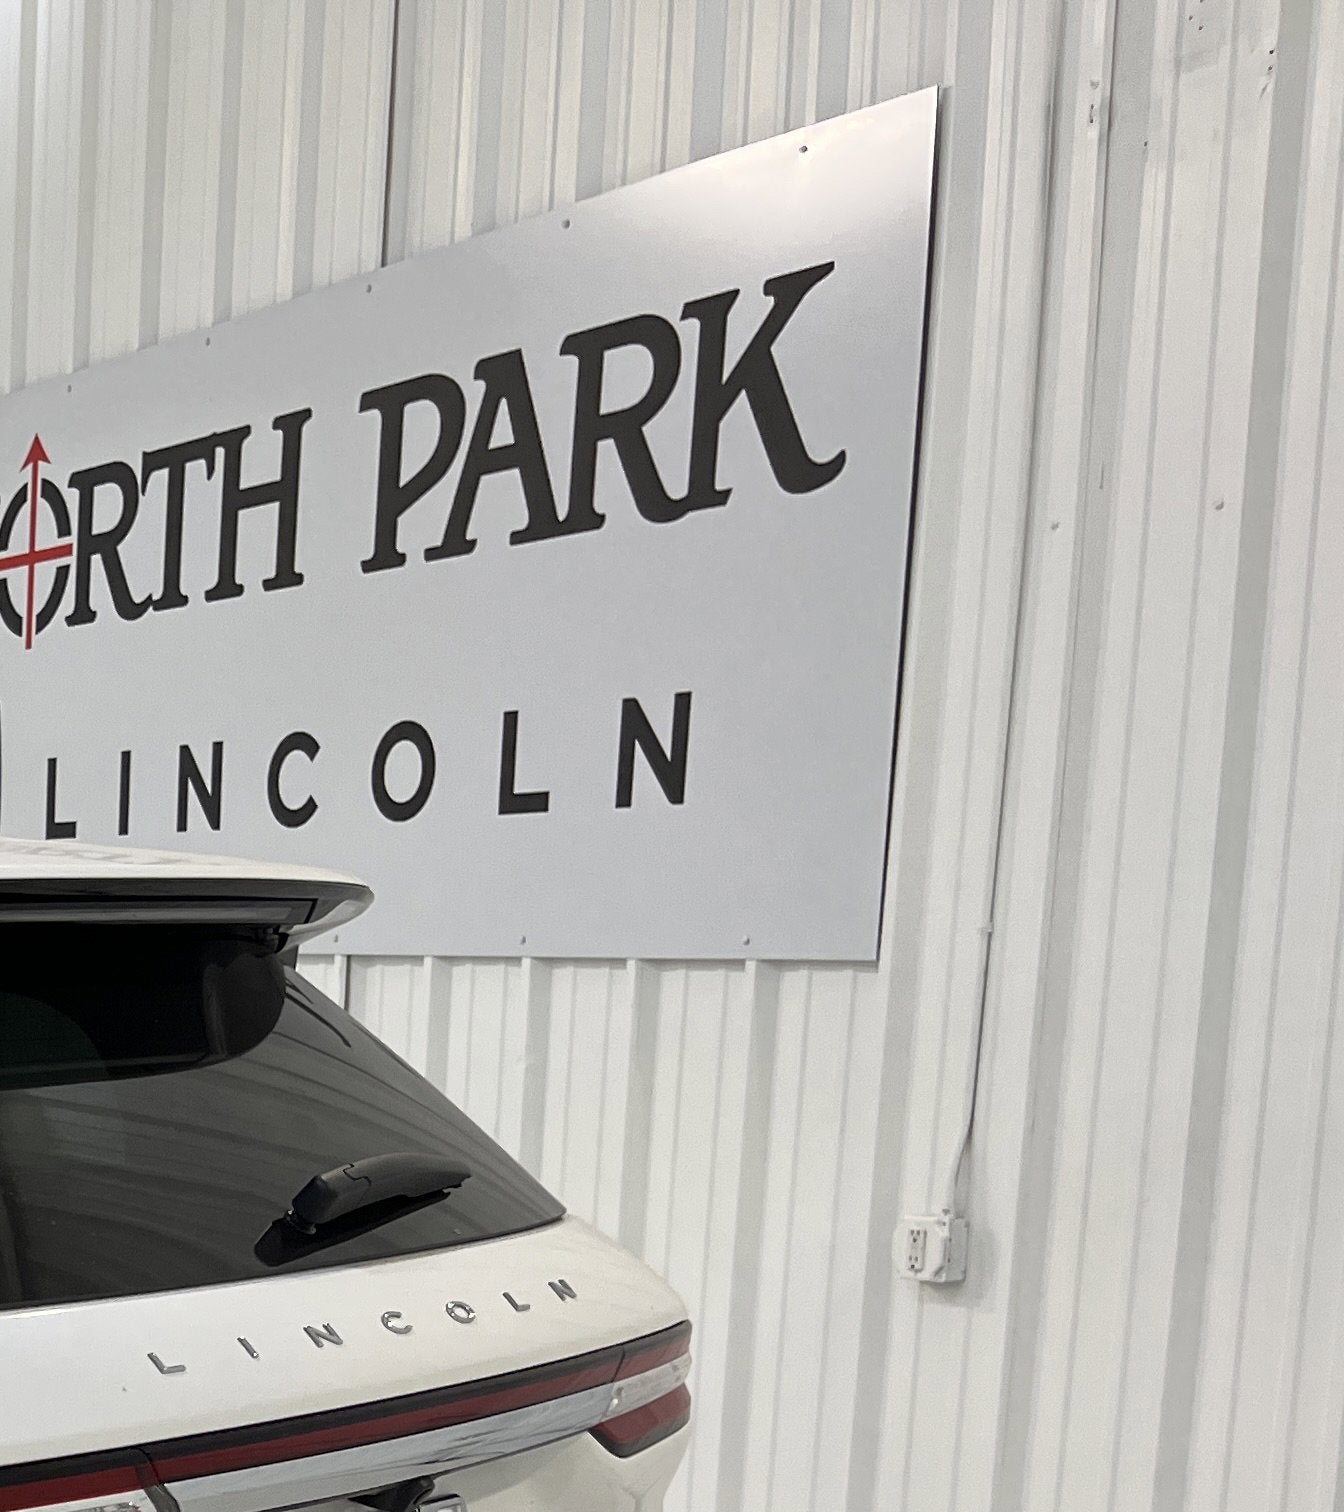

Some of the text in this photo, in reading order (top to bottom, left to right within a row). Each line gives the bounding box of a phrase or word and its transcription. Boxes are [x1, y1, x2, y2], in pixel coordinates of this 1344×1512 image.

[359, 261, 847, 574] PARK
[44, 690, 693, 840] LINCOLN
[146, 1278, 578, 1375] LINCOLN
